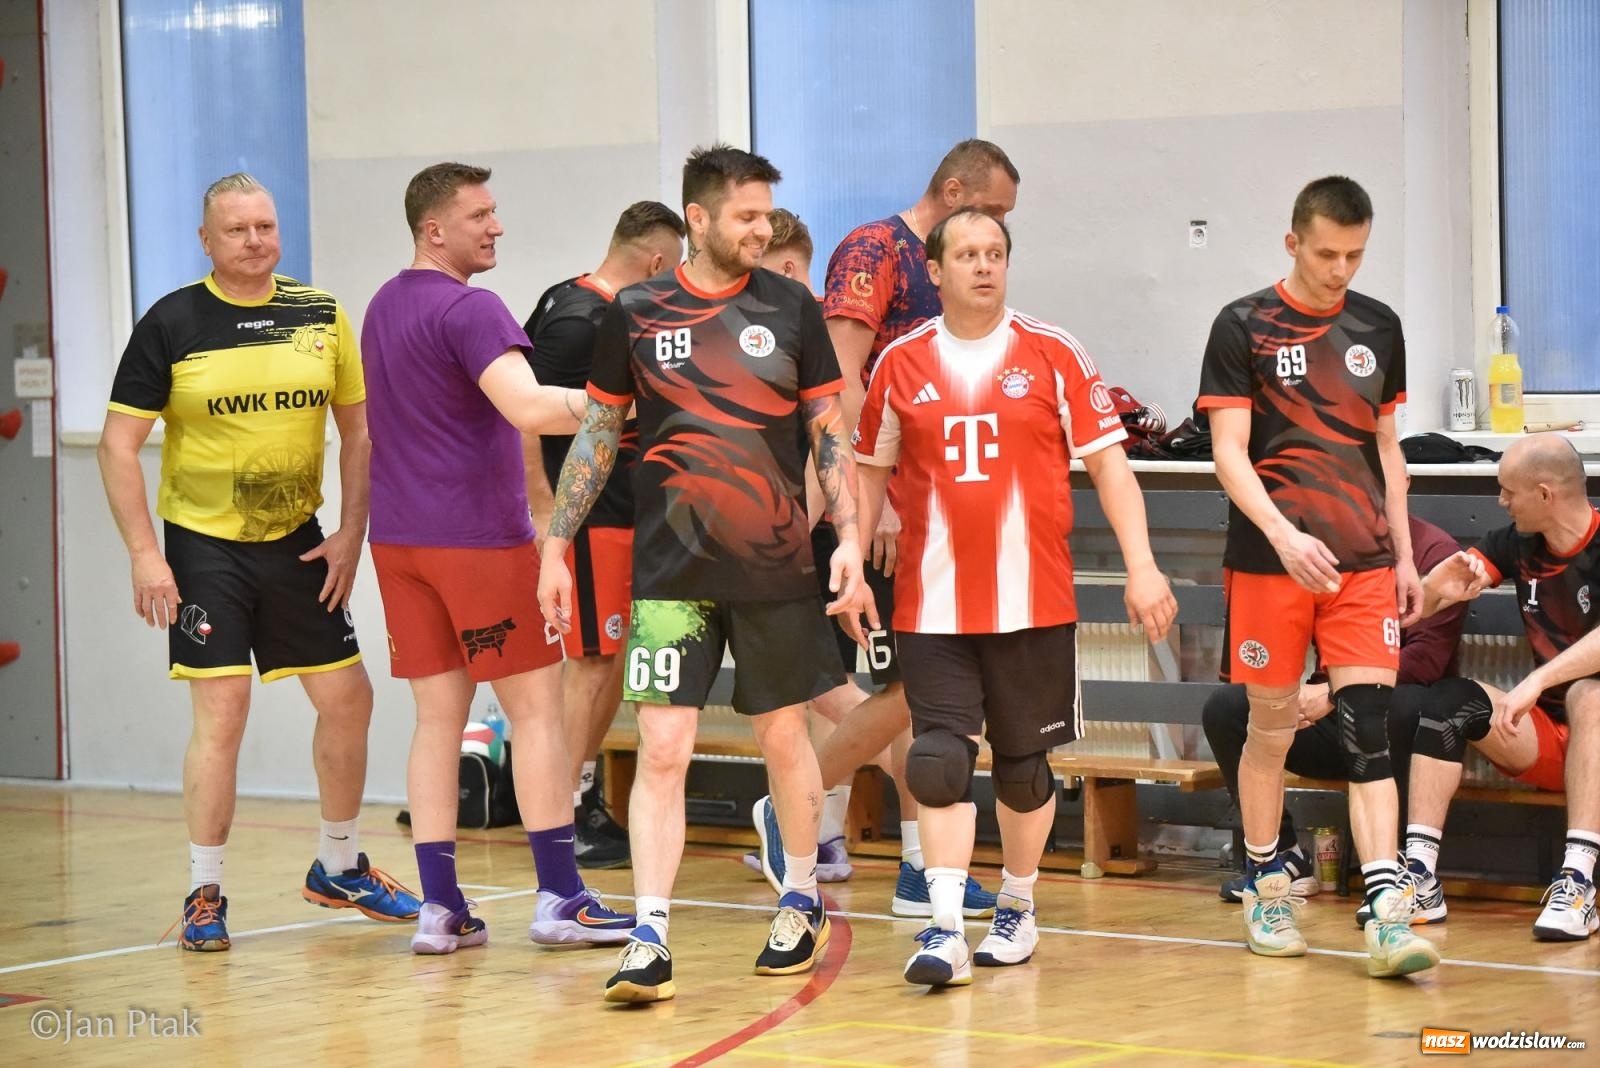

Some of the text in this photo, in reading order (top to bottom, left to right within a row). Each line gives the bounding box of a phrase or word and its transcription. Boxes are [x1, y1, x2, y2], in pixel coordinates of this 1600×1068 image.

[237, 320, 274, 329] regio
[655, 327, 692, 362] 69
[1276, 344, 1307, 378] 69
[207, 389, 330, 416] KWK ROW
[943, 413, 999, 483] T
[1527, 578, 1539, 606] 1
[867, 629, 891, 670] 6
[628, 646, 681, 692] 69
[1039, 720, 1066, 734] adidas
